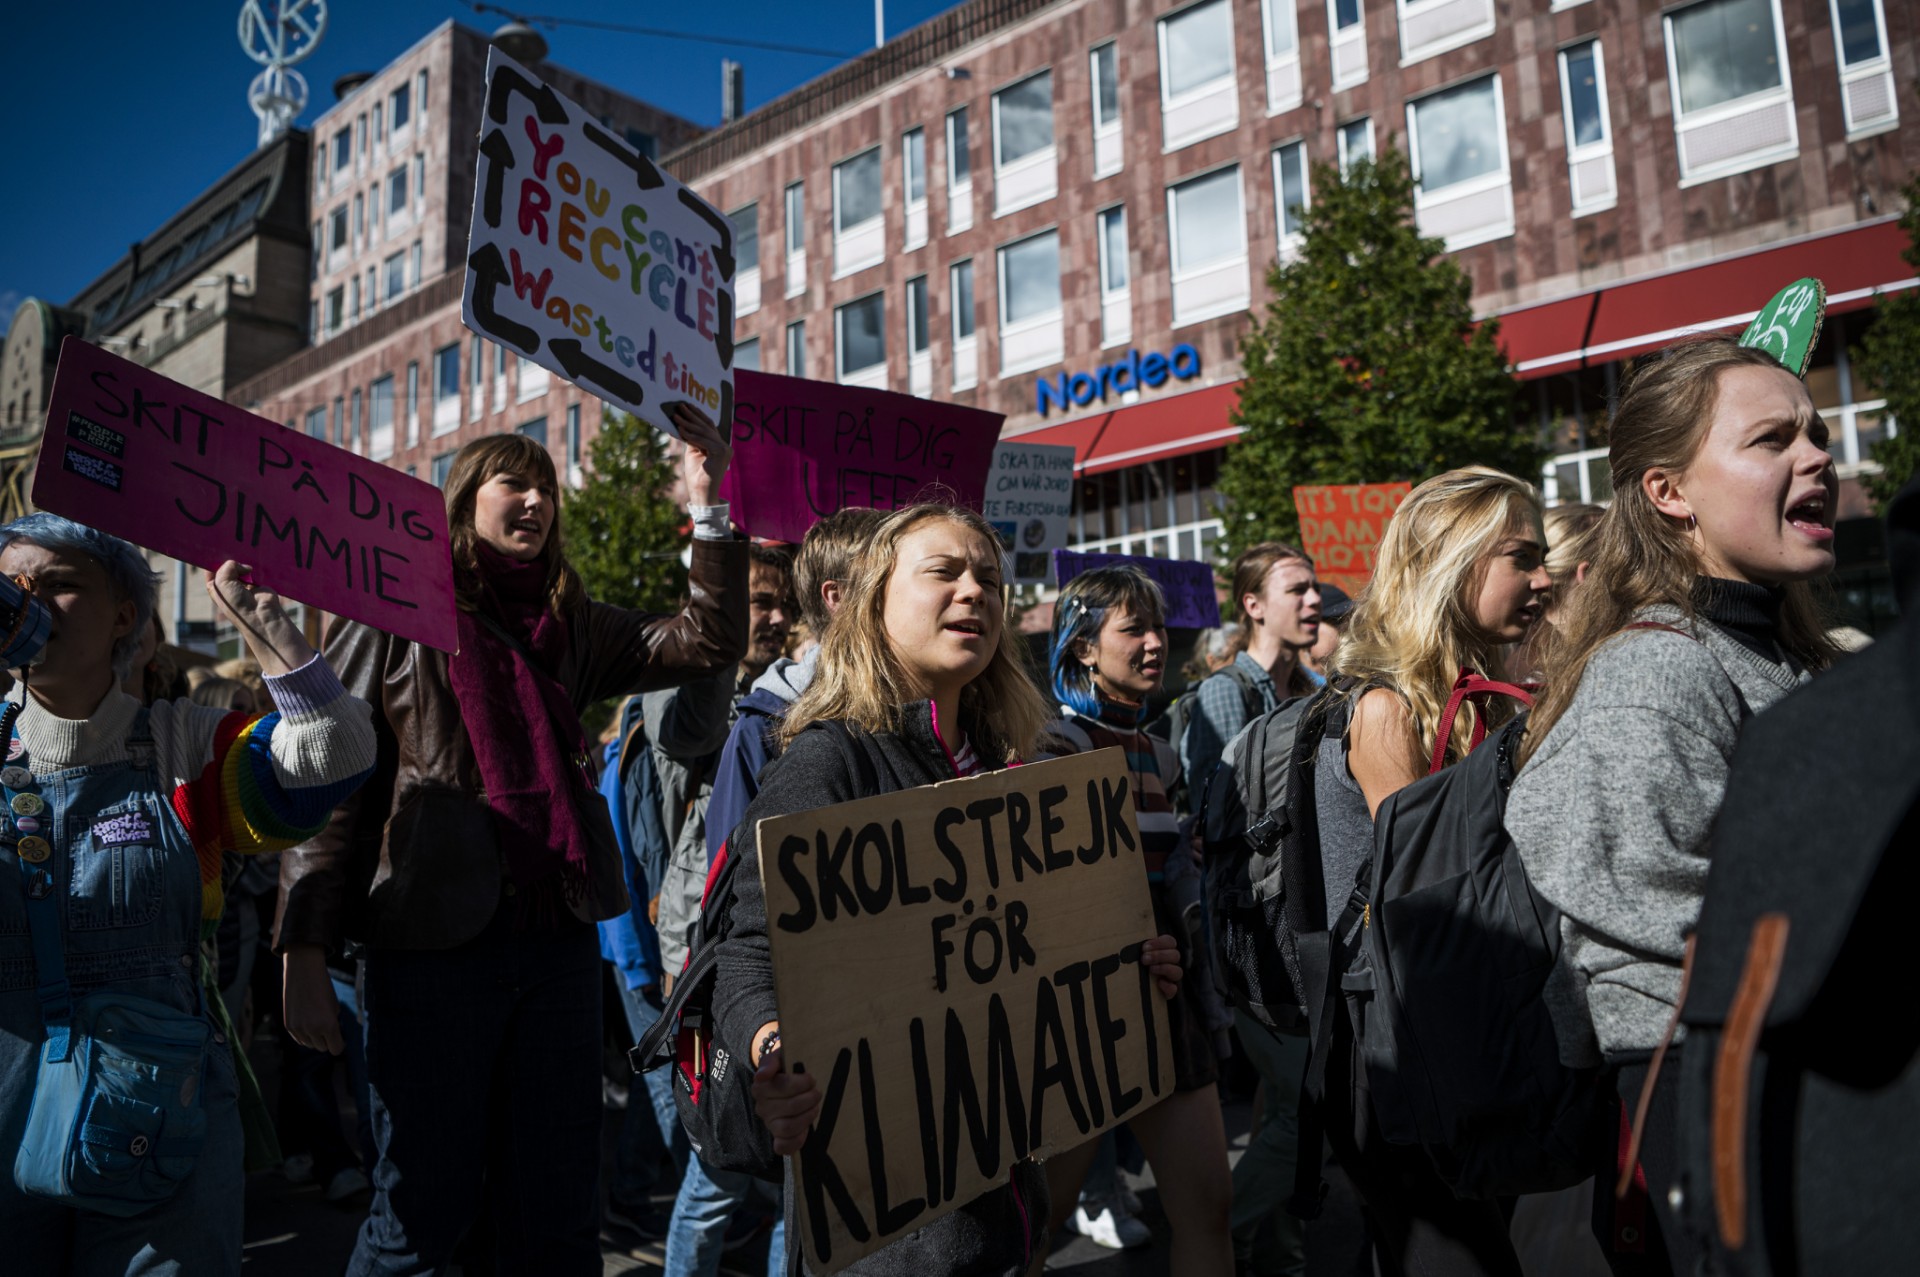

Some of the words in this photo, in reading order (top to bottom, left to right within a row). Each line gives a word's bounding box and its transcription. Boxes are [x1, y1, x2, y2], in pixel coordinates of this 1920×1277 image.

[524, 115, 611, 218] You
[518, 178, 715, 342] RECYCLE
[509, 248, 657, 382] Wasted
[663, 351, 720, 411] time
[1036, 343, 1201, 417] Nordea
[71, 415, 125, 445] #PEOPLE
[78, 428, 120, 454] PROFIT
[91, 371, 225, 456] SKIT
[258, 436, 330, 504] PÅ
[348, 472, 435, 541] DIG
[733, 403, 819, 449] SKIT
[834, 407, 876, 457] PÅ
[895, 416, 961, 470] DIG
[999, 452, 1028, 471] SKA
[1031, 454, 1047, 471] TA
[997, 475, 1019, 492] OM
[171, 461, 419, 609] JIMMIE
[1302, 517, 1390, 545] DAM
[1307, 543, 1376, 571] HOT
[776, 775, 1137, 935] SKOLSTREJK
[930, 895, 1037, 994] FÖR
[710, 1048, 725, 1079] 250
[791, 939, 1164, 1264] KLIMATET
